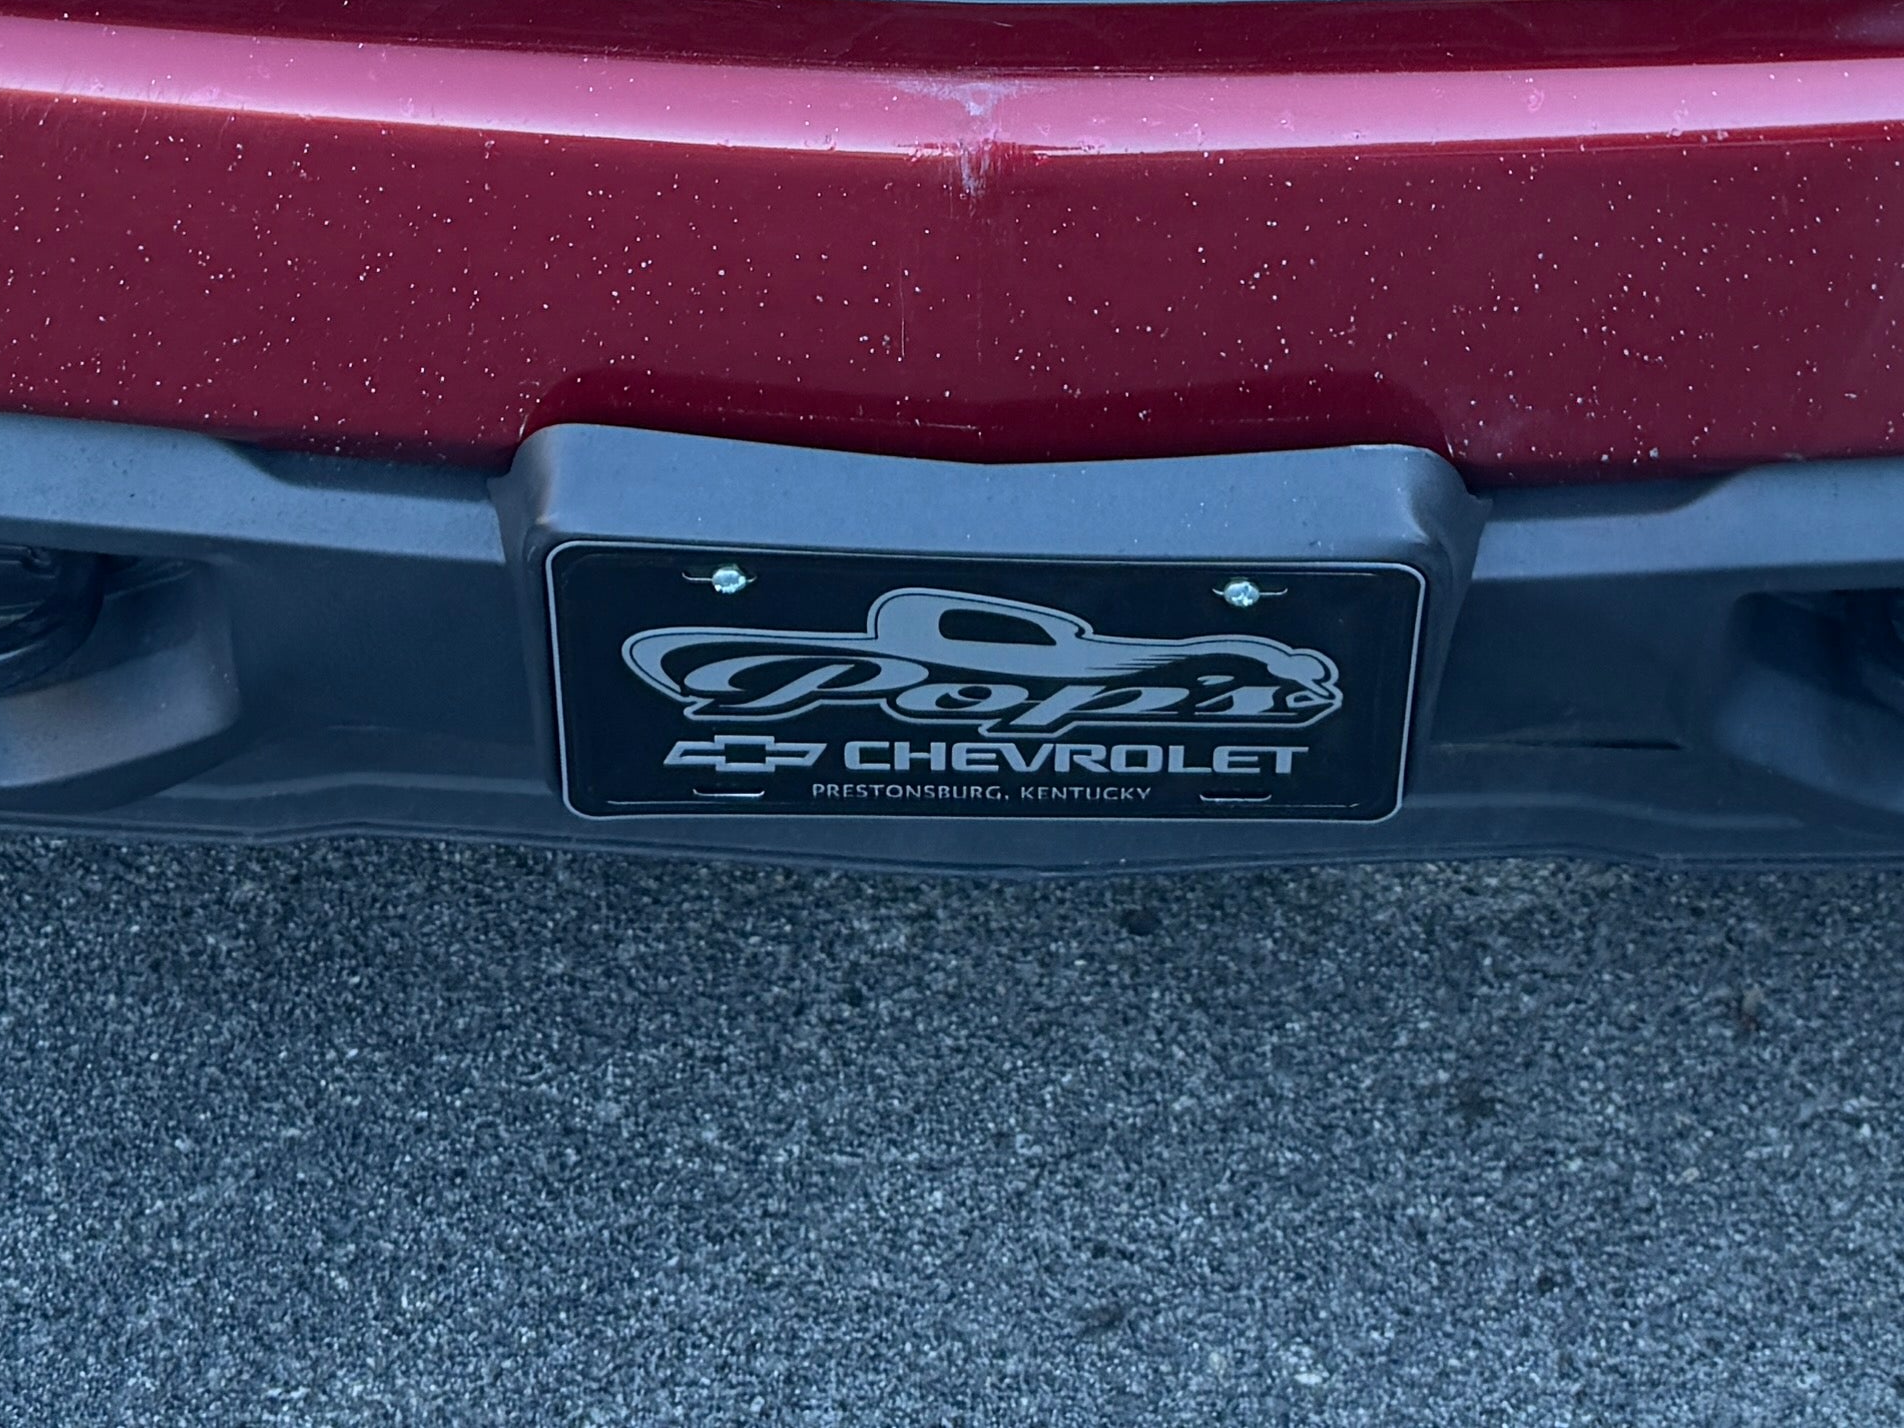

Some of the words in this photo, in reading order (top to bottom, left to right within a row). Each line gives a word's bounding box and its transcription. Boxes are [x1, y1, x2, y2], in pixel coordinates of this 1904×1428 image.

[683, 655, 1297, 726] Pop's
[844, 740, 1309, 774] CHEVROLET
[813, 784, 1010, 801] PRESTONSBURG,
[1020, 786, 1152, 801] KENTUCKY
